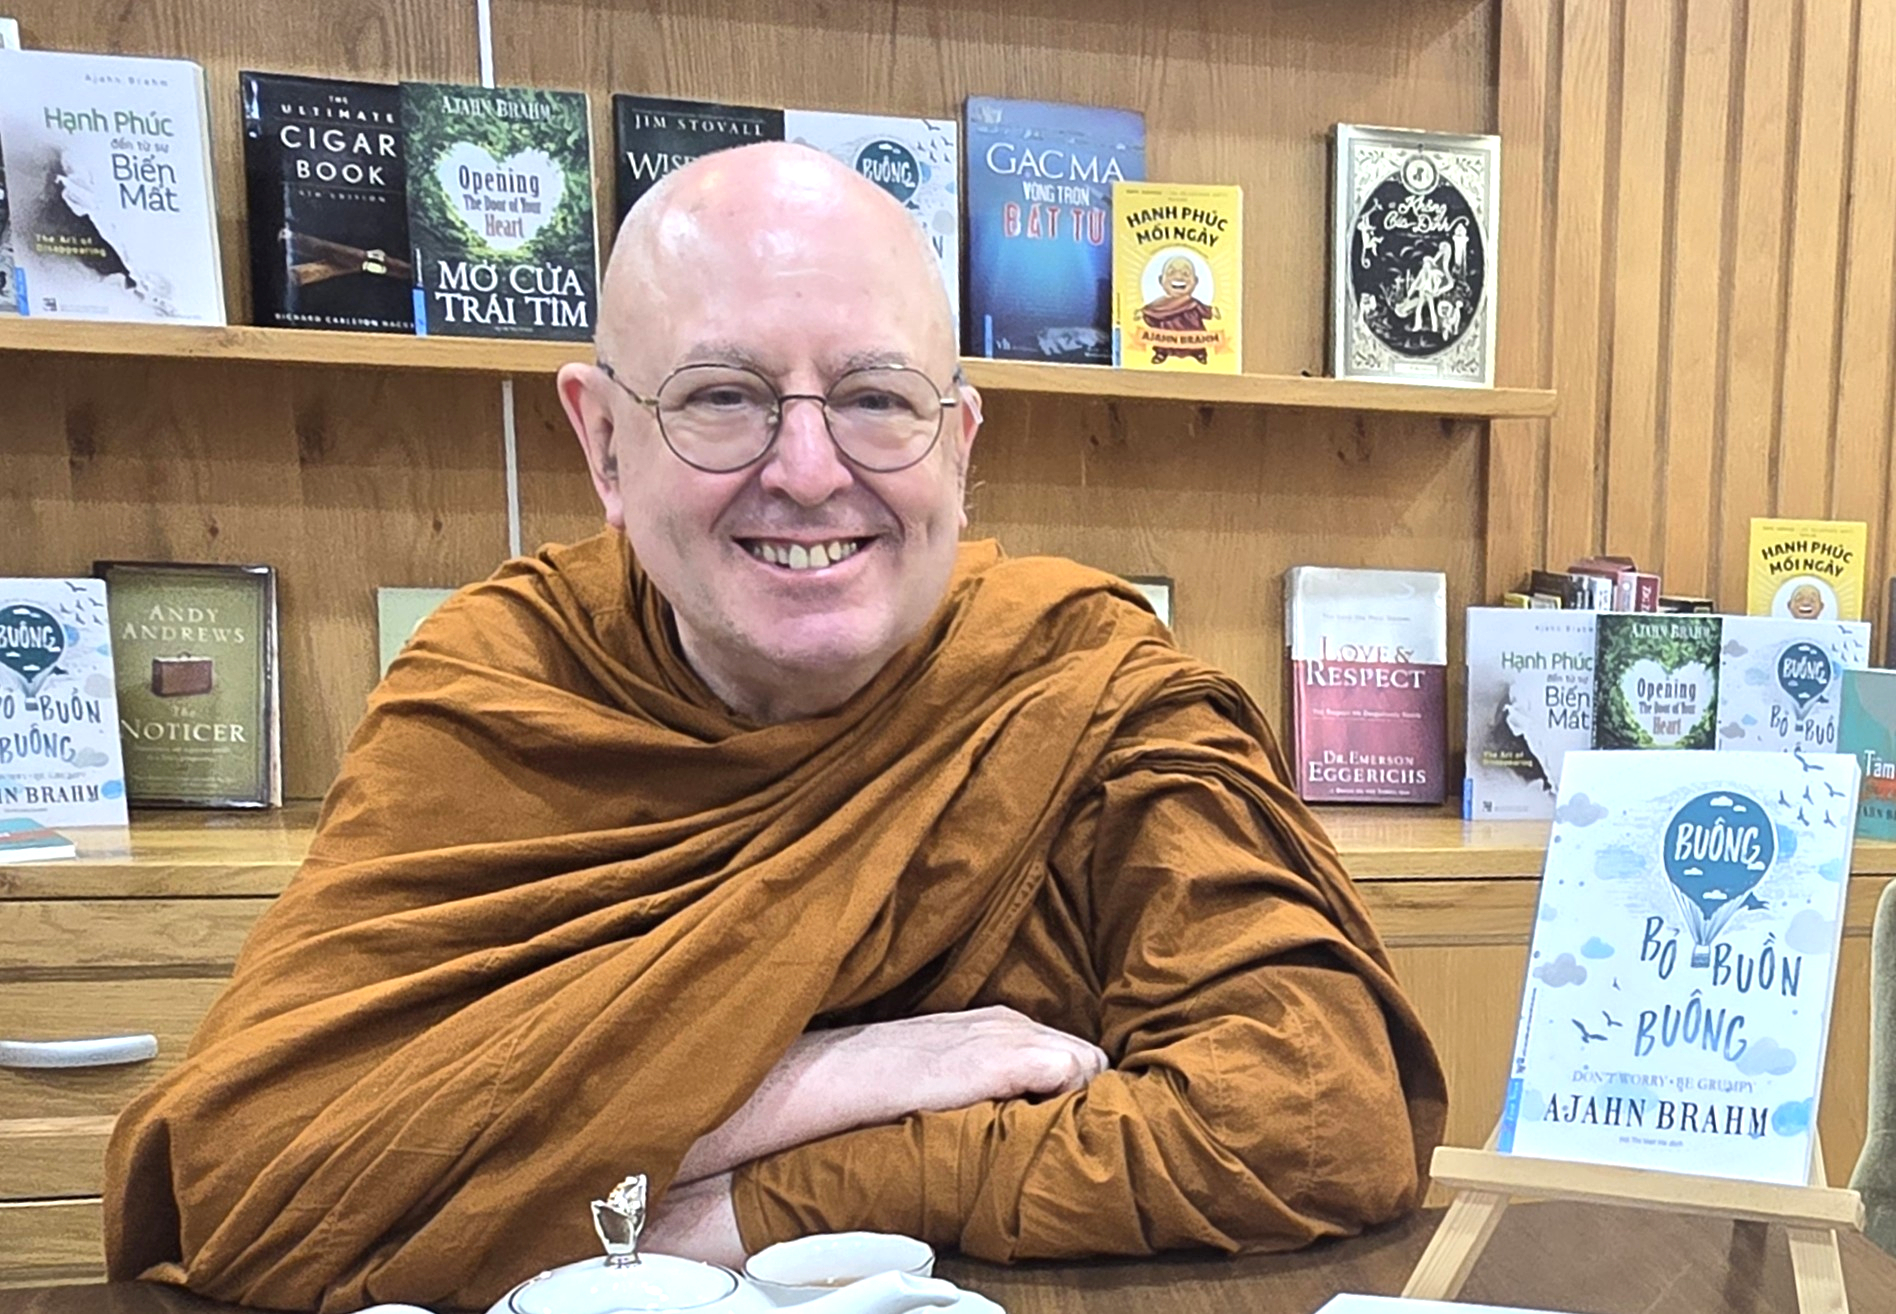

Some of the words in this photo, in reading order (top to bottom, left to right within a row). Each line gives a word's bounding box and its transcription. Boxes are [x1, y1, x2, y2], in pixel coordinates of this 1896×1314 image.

[44, 107, 109, 134] Hạnh
[114, 111, 174, 136] Phúc
[281, 104, 395, 123] ULTIMATE
[496, 98, 551, 119] BRAHM
[635, 114, 667, 130] JIM
[677, 119, 764, 136] STOVALL
[280, 125, 397, 158] CIGAR
[111, 153, 176, 187] Biến
[296, 159, 386, 186] BOOK
[459, 164, 539, 198] Opening
[863, 155, 914, 187] BUÔNG
[1069, 153, 1125, 184] MA
[119, 183, 180, 212] Mất
[463, 194, 482, 211] The
[485, 213, 524, 239] Heart
[1182, 206, 1229, 232] PHÚC
[1174, 226, 1219, 247] NGÀY
[437, 259, 498, 292] MỞ
[510, 262, 585, 297] CỬA
[434, 291, 517, 325] TRÁI
[524, 296, 589, 328] TIM
[1811, 541, 1854, 564] PHÚC
[149, 604, 218, 623] ANDY
[122, 622, 245, 643] ANDREWS
[1305, 659, 1426, 689] RESPECT
[1502, 651, 1547, 673] Hạnh
[1552, 651, 1593, 672] Phúc
[1545, 685, 1591, 709] Biến
[1637, 678, 1697, 701] Opening
[40, 687, 101, 724] BUỒN
[121, 719, 247, 742] NOTICER
[1548, 708, 1590, 730] Mất
[1350, 750, 1415, 766] EMERSON
[1309, 761, 1427, 785] EGGERICHS
[25, 785, 99, 804] BRAHM
[1674, 816, 1761, 865] BUÔNG
[1640, 916, 1680, 980] BỎ
[1712, 932, 1802, 997] BUỒN
[1634, 988, 1747, 1062] BUÔNG
[1543, 1092, 1647, 1127] AJAHN
[1656, 1099, 1769, 1137] BRAHM
